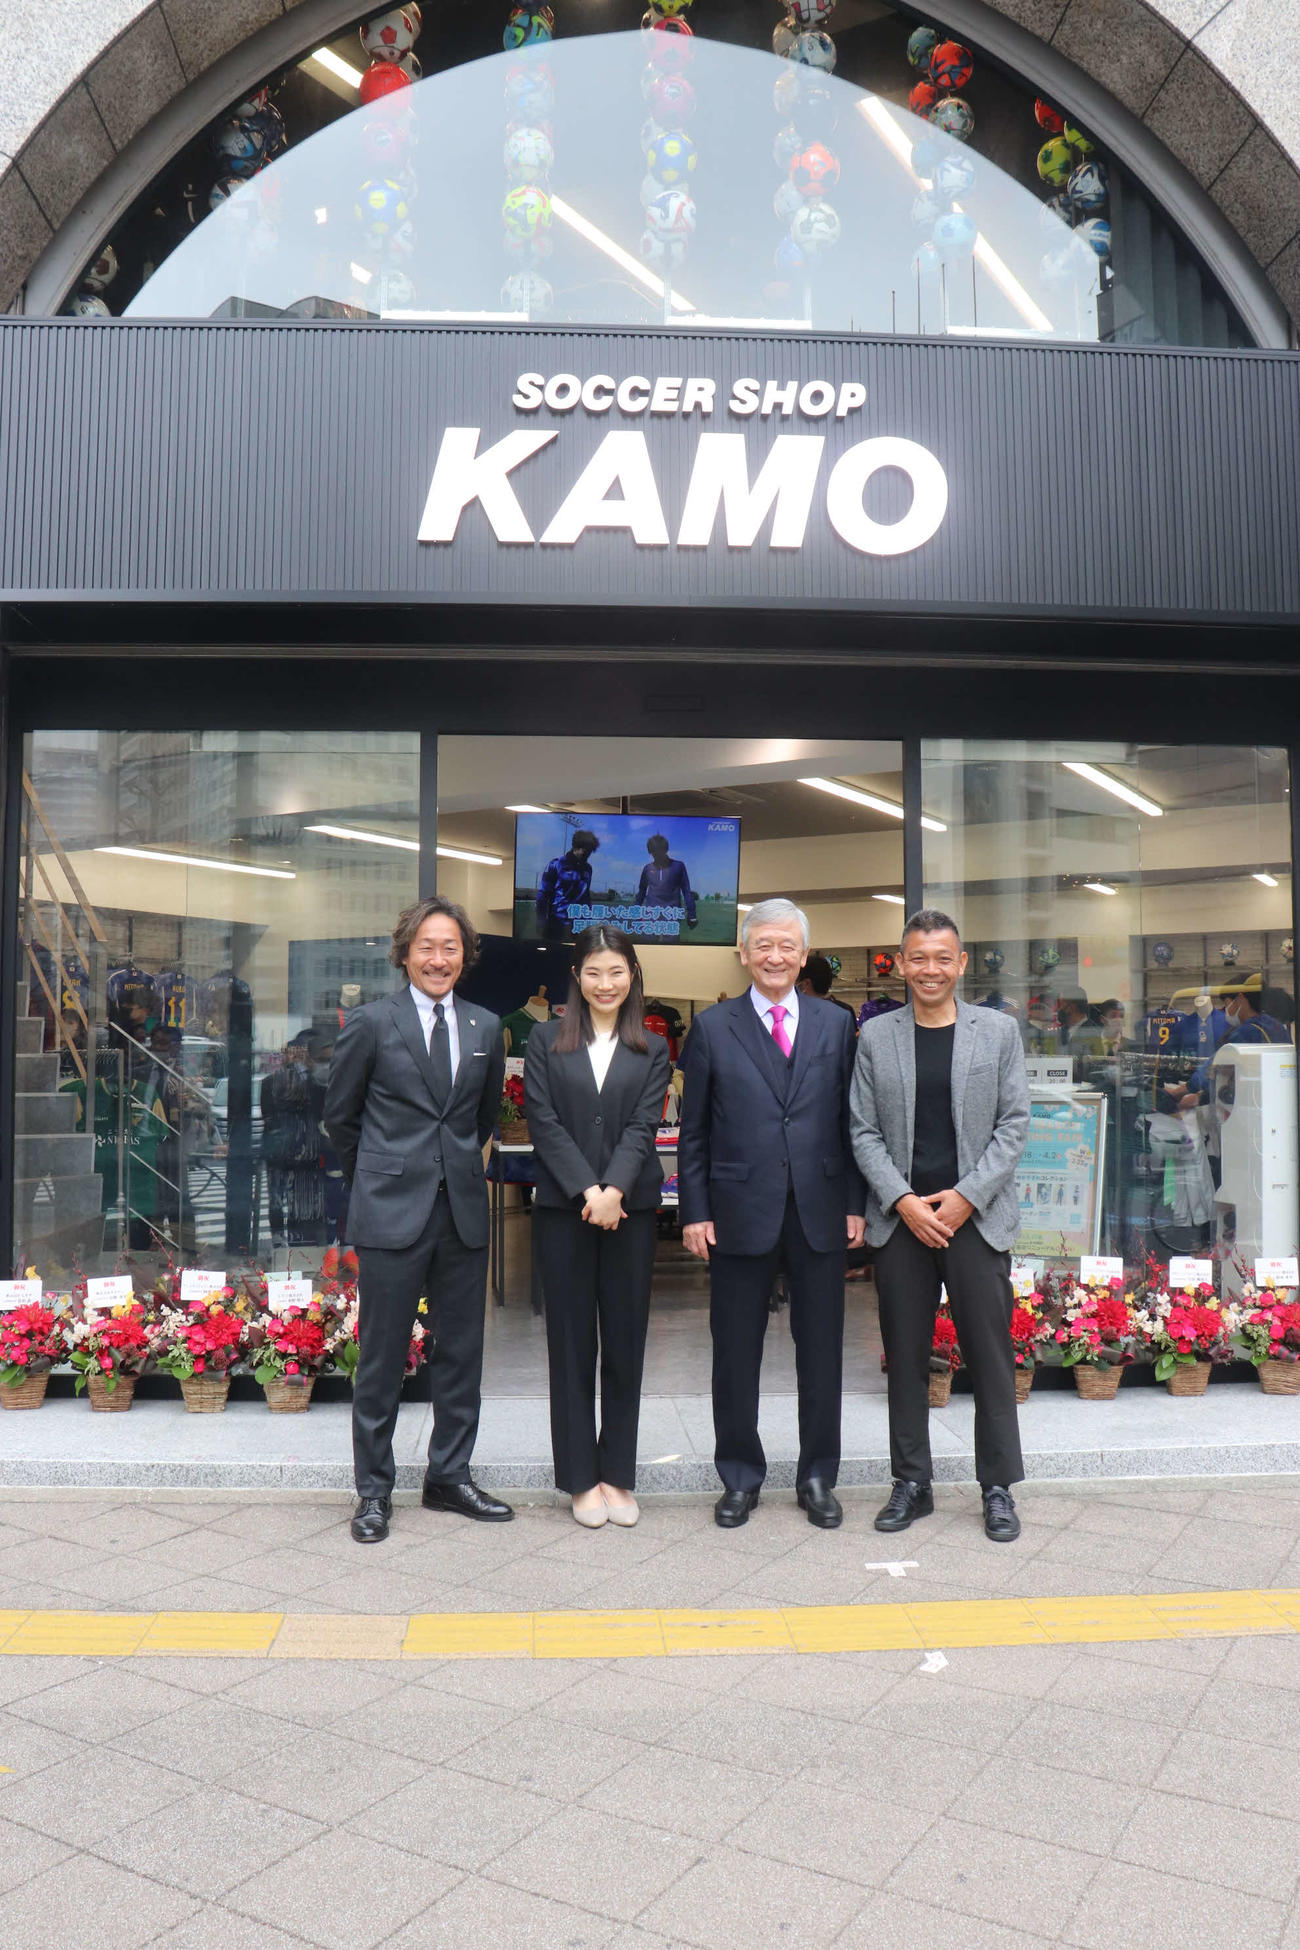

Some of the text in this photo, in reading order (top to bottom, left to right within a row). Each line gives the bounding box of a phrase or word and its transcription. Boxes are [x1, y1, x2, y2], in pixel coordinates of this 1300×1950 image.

[512, 372, 867, 417] SOCCER SHOP
[416, 427, 949, 557] KAMO
[707, 823, 735, 832] KAMO
[1152, 1016, 1176, 1025] MITOMA
[1158, 1026, 1170, 1046] 9
[1048, 1070, 1066, 1078] CLOSE
